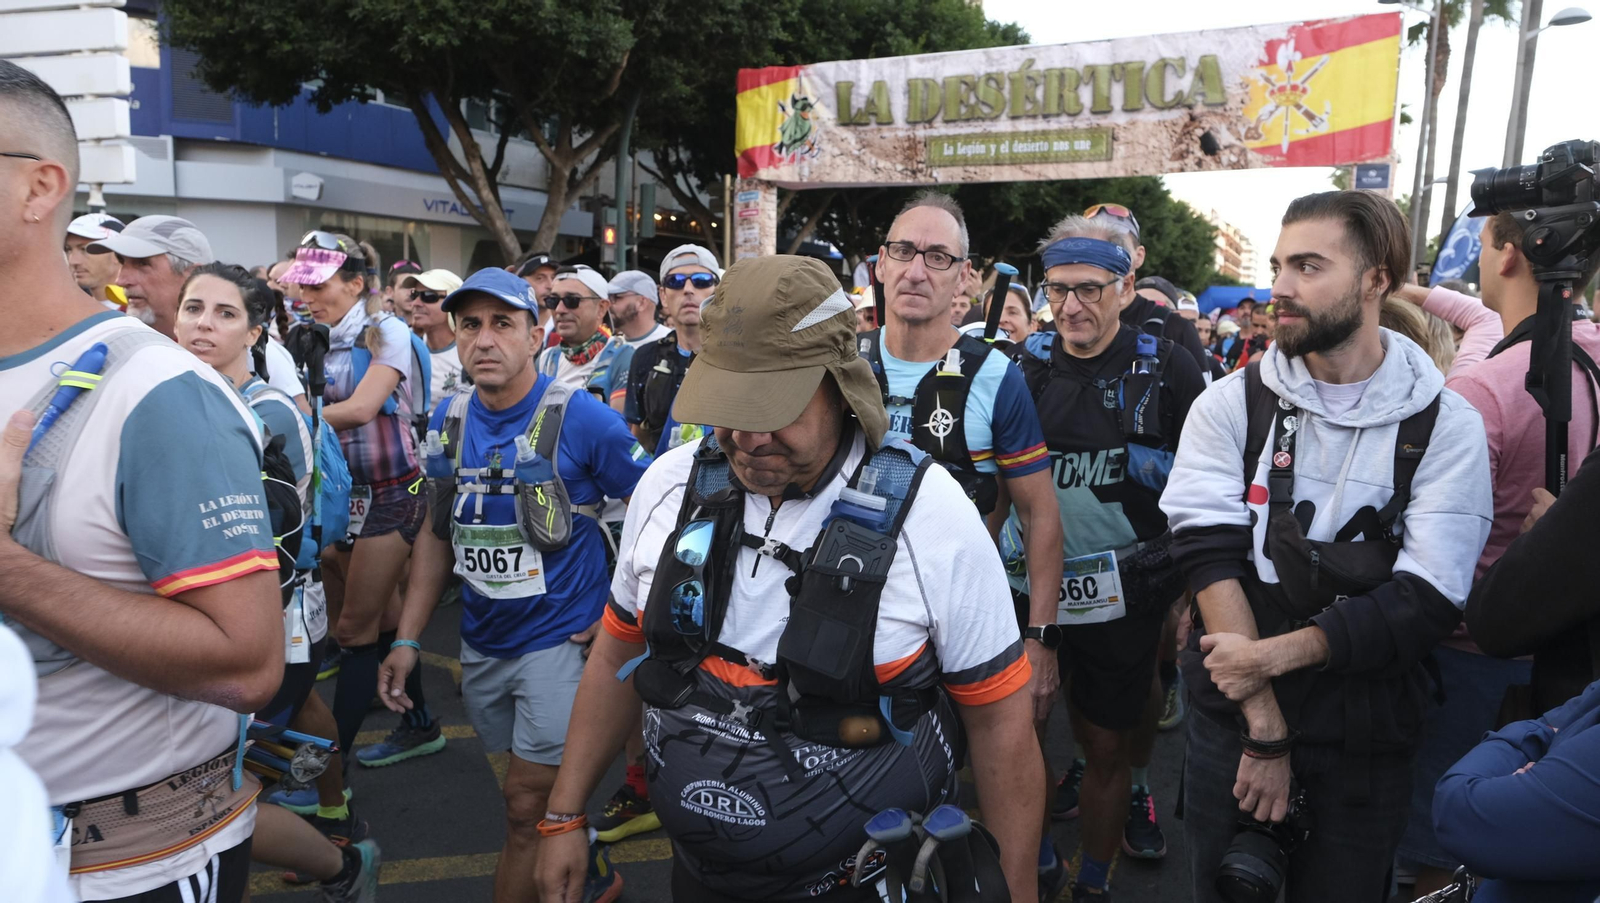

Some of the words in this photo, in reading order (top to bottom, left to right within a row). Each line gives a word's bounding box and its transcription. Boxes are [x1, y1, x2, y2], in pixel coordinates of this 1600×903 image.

[835, 80, 894, 126] LA
[906, 54, 1228, 124] DESÉRTICA
[943, 143, 954, 156] La
[957, 142, 986, 157] Legión
[989, 142, 997, 157] y
[1000, 140, 1009, 154] el
[1012, 138, 1049, 153] desierto
[1053, 140, 1070, 151] nos
[1074, 139, 1091, 150] une
[423, 199, 514, 222] VITALT
[199, 500, 218, 514] LA
[202, 517, 221, 529] EL
[464, 546, 523, 574] 5067
[700, 791, 748, 814] DRL
[728, 785, 766, 817] ALUMINIO
[681, 799, 702, 814] DAVID
[703, 809, 736, 823] ROMERO
[737, 817, 766, 827] LAGOS
